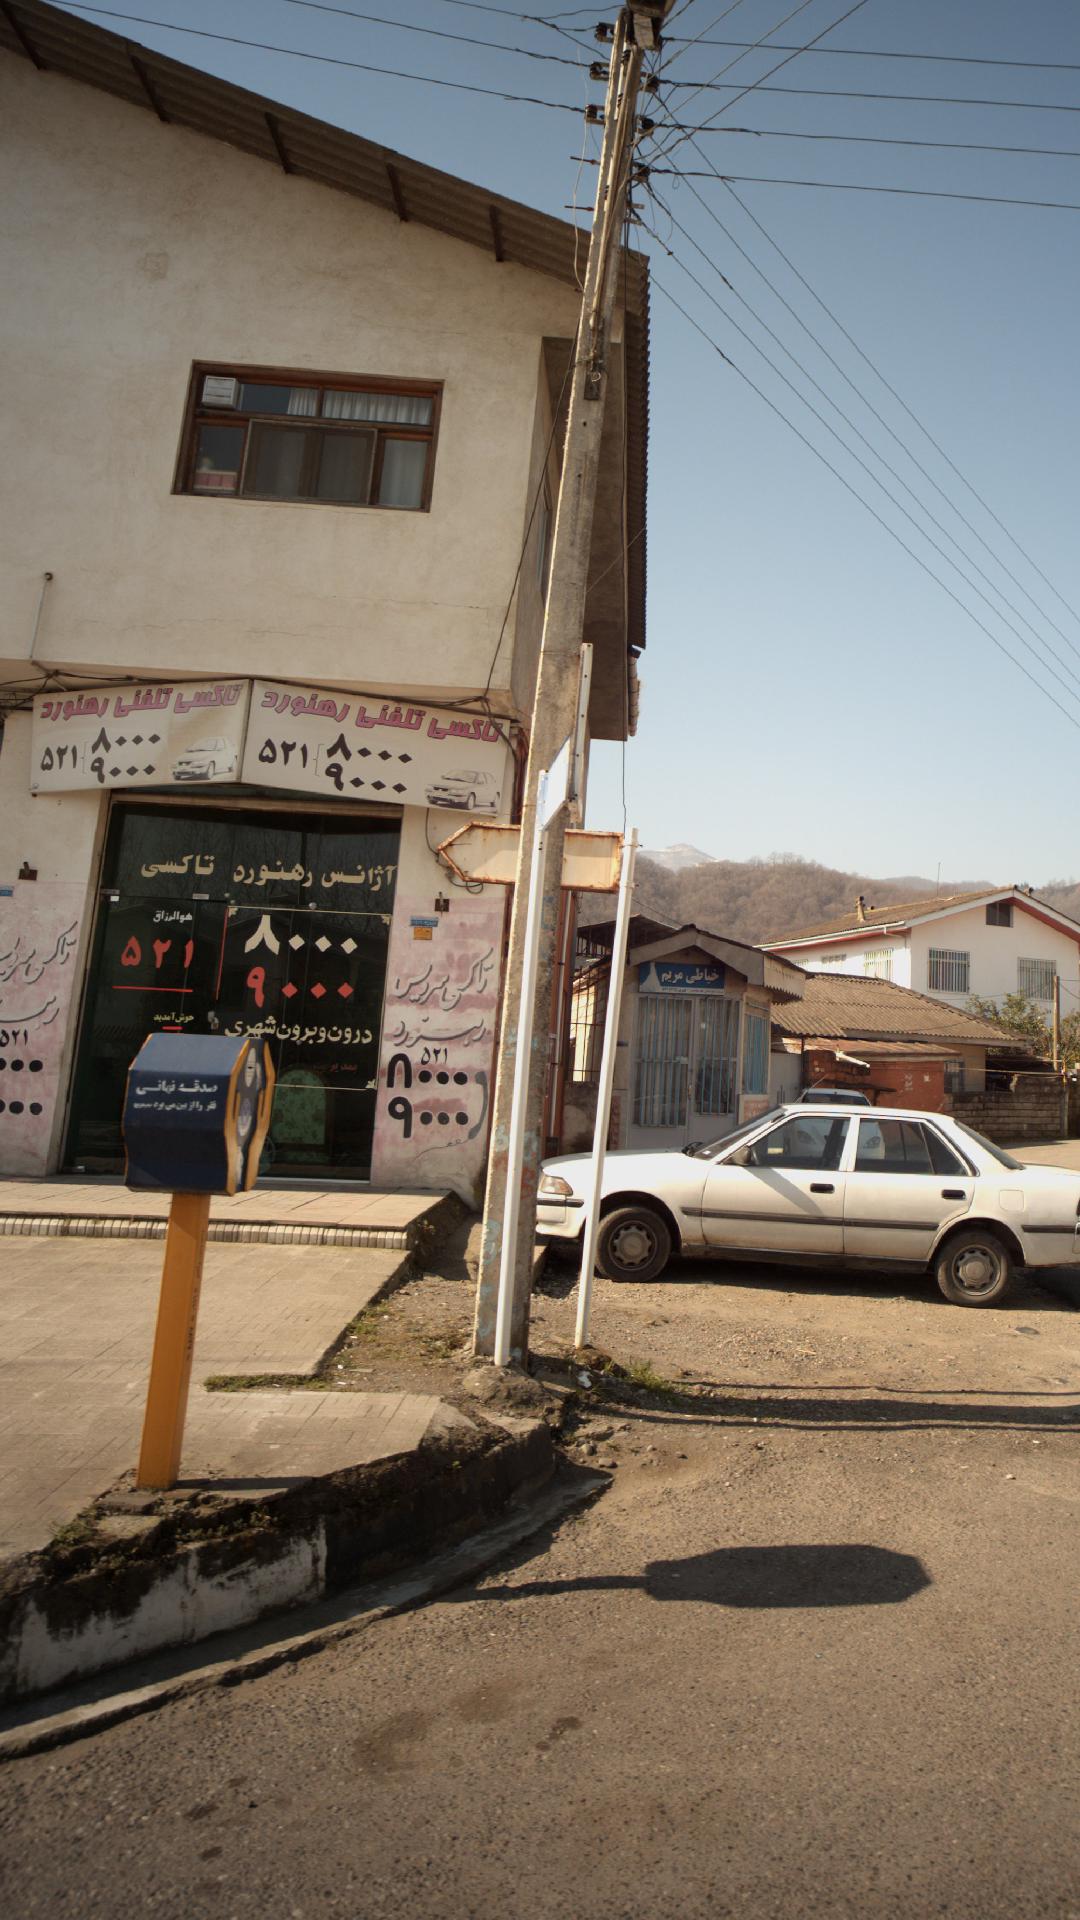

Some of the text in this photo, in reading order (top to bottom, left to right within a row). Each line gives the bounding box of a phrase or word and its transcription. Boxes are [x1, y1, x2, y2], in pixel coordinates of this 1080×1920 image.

[40, 684, 243, 721] تاکسی تلفنی رهنورد
[261, 691, 503, 743] تاکسی تلفنی رهنورد
[91, 727, 161, 753] ۸۰۰۰
[258, 738, 308, 769] ۵۲۱
[326, 733, 413, 763] ۸۰۰۰
[40, 744, 78, 772] ۵۲۱
[90, 756, 156, 784] ۹۰۰۰
[325, 762, 408, 794] ۹۰۰۰
[140, 853, 398, 891] آژانس رهنورد تاکسی
[244, 914, 358, 955] ۸۰۰۰
[121, 935, 194, 969] ۵۲۱
[246, 966, 354, 1009] ۹۰۰۰
[224, 1015, 277, 1039] شهری
[386, 1053, 468, 1088] ۸۰۰۰
[421, 1047, 448, 1065] ۵۲۱
[388, 1096, 469, 1138] ۹۰۰۰
